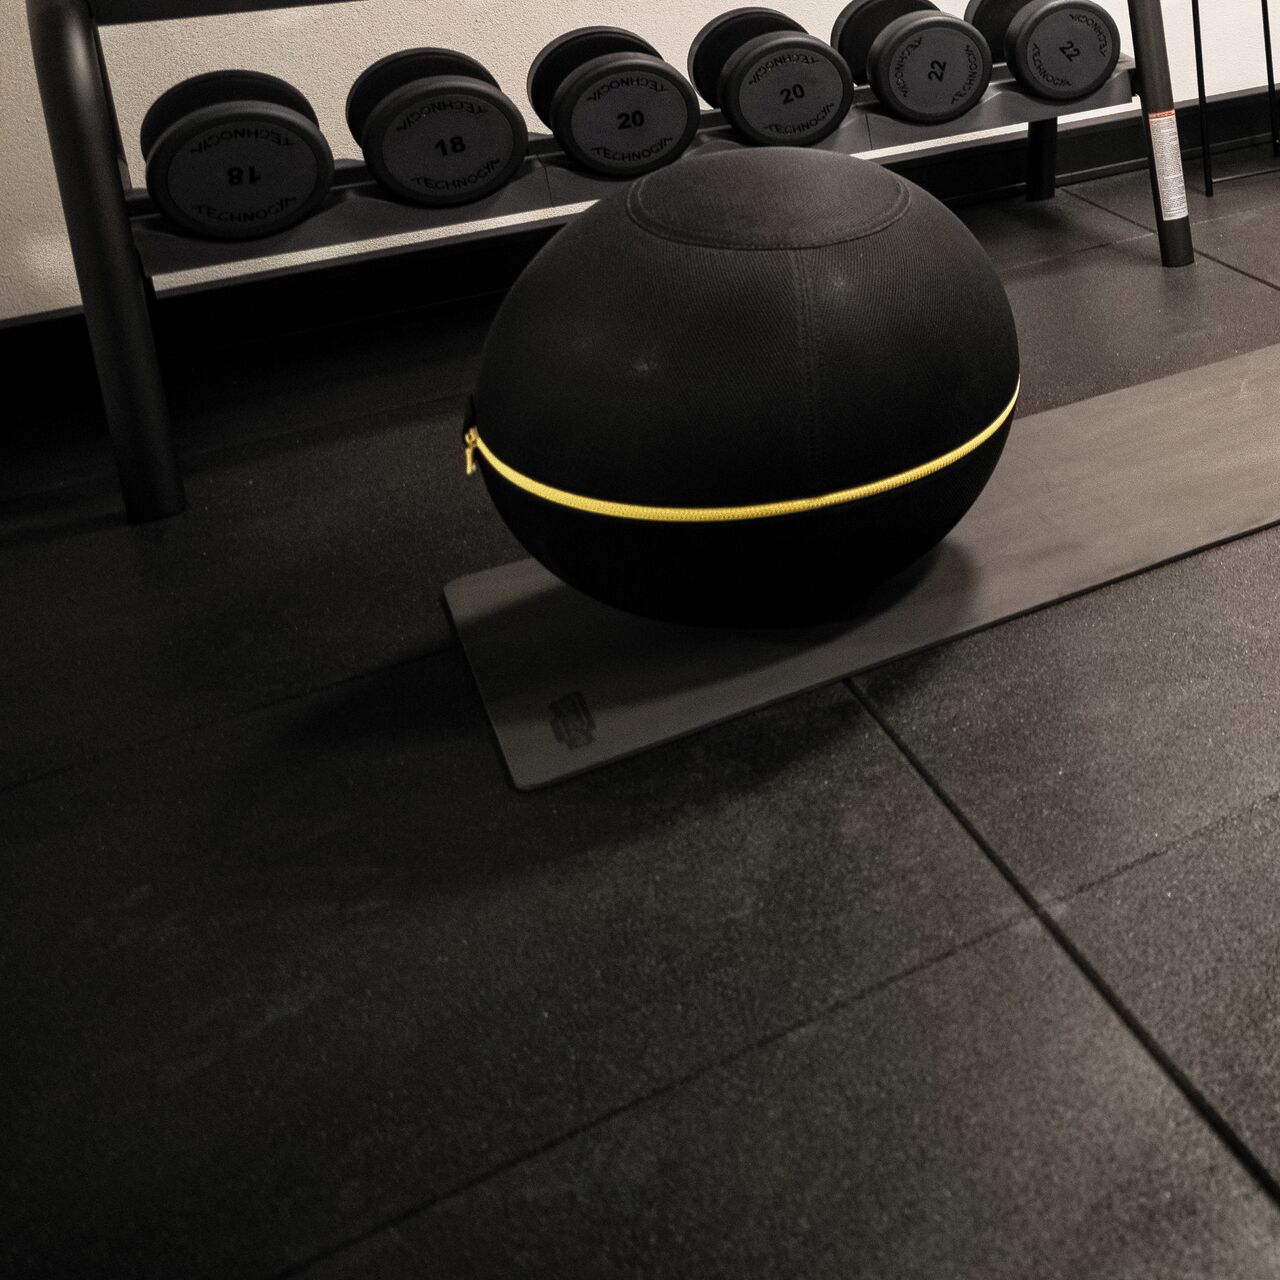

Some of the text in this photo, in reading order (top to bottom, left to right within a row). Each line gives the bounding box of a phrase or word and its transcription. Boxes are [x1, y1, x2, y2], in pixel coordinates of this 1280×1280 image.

[1059, 40, 1081, 62] 22
[928, 60, 947, 82] 22
[780, 84, 805, 104] 20
[617, 111, 645, 130] 20
[435, 136, 466, 156] 18
[227, 166, 261, 185] 18
